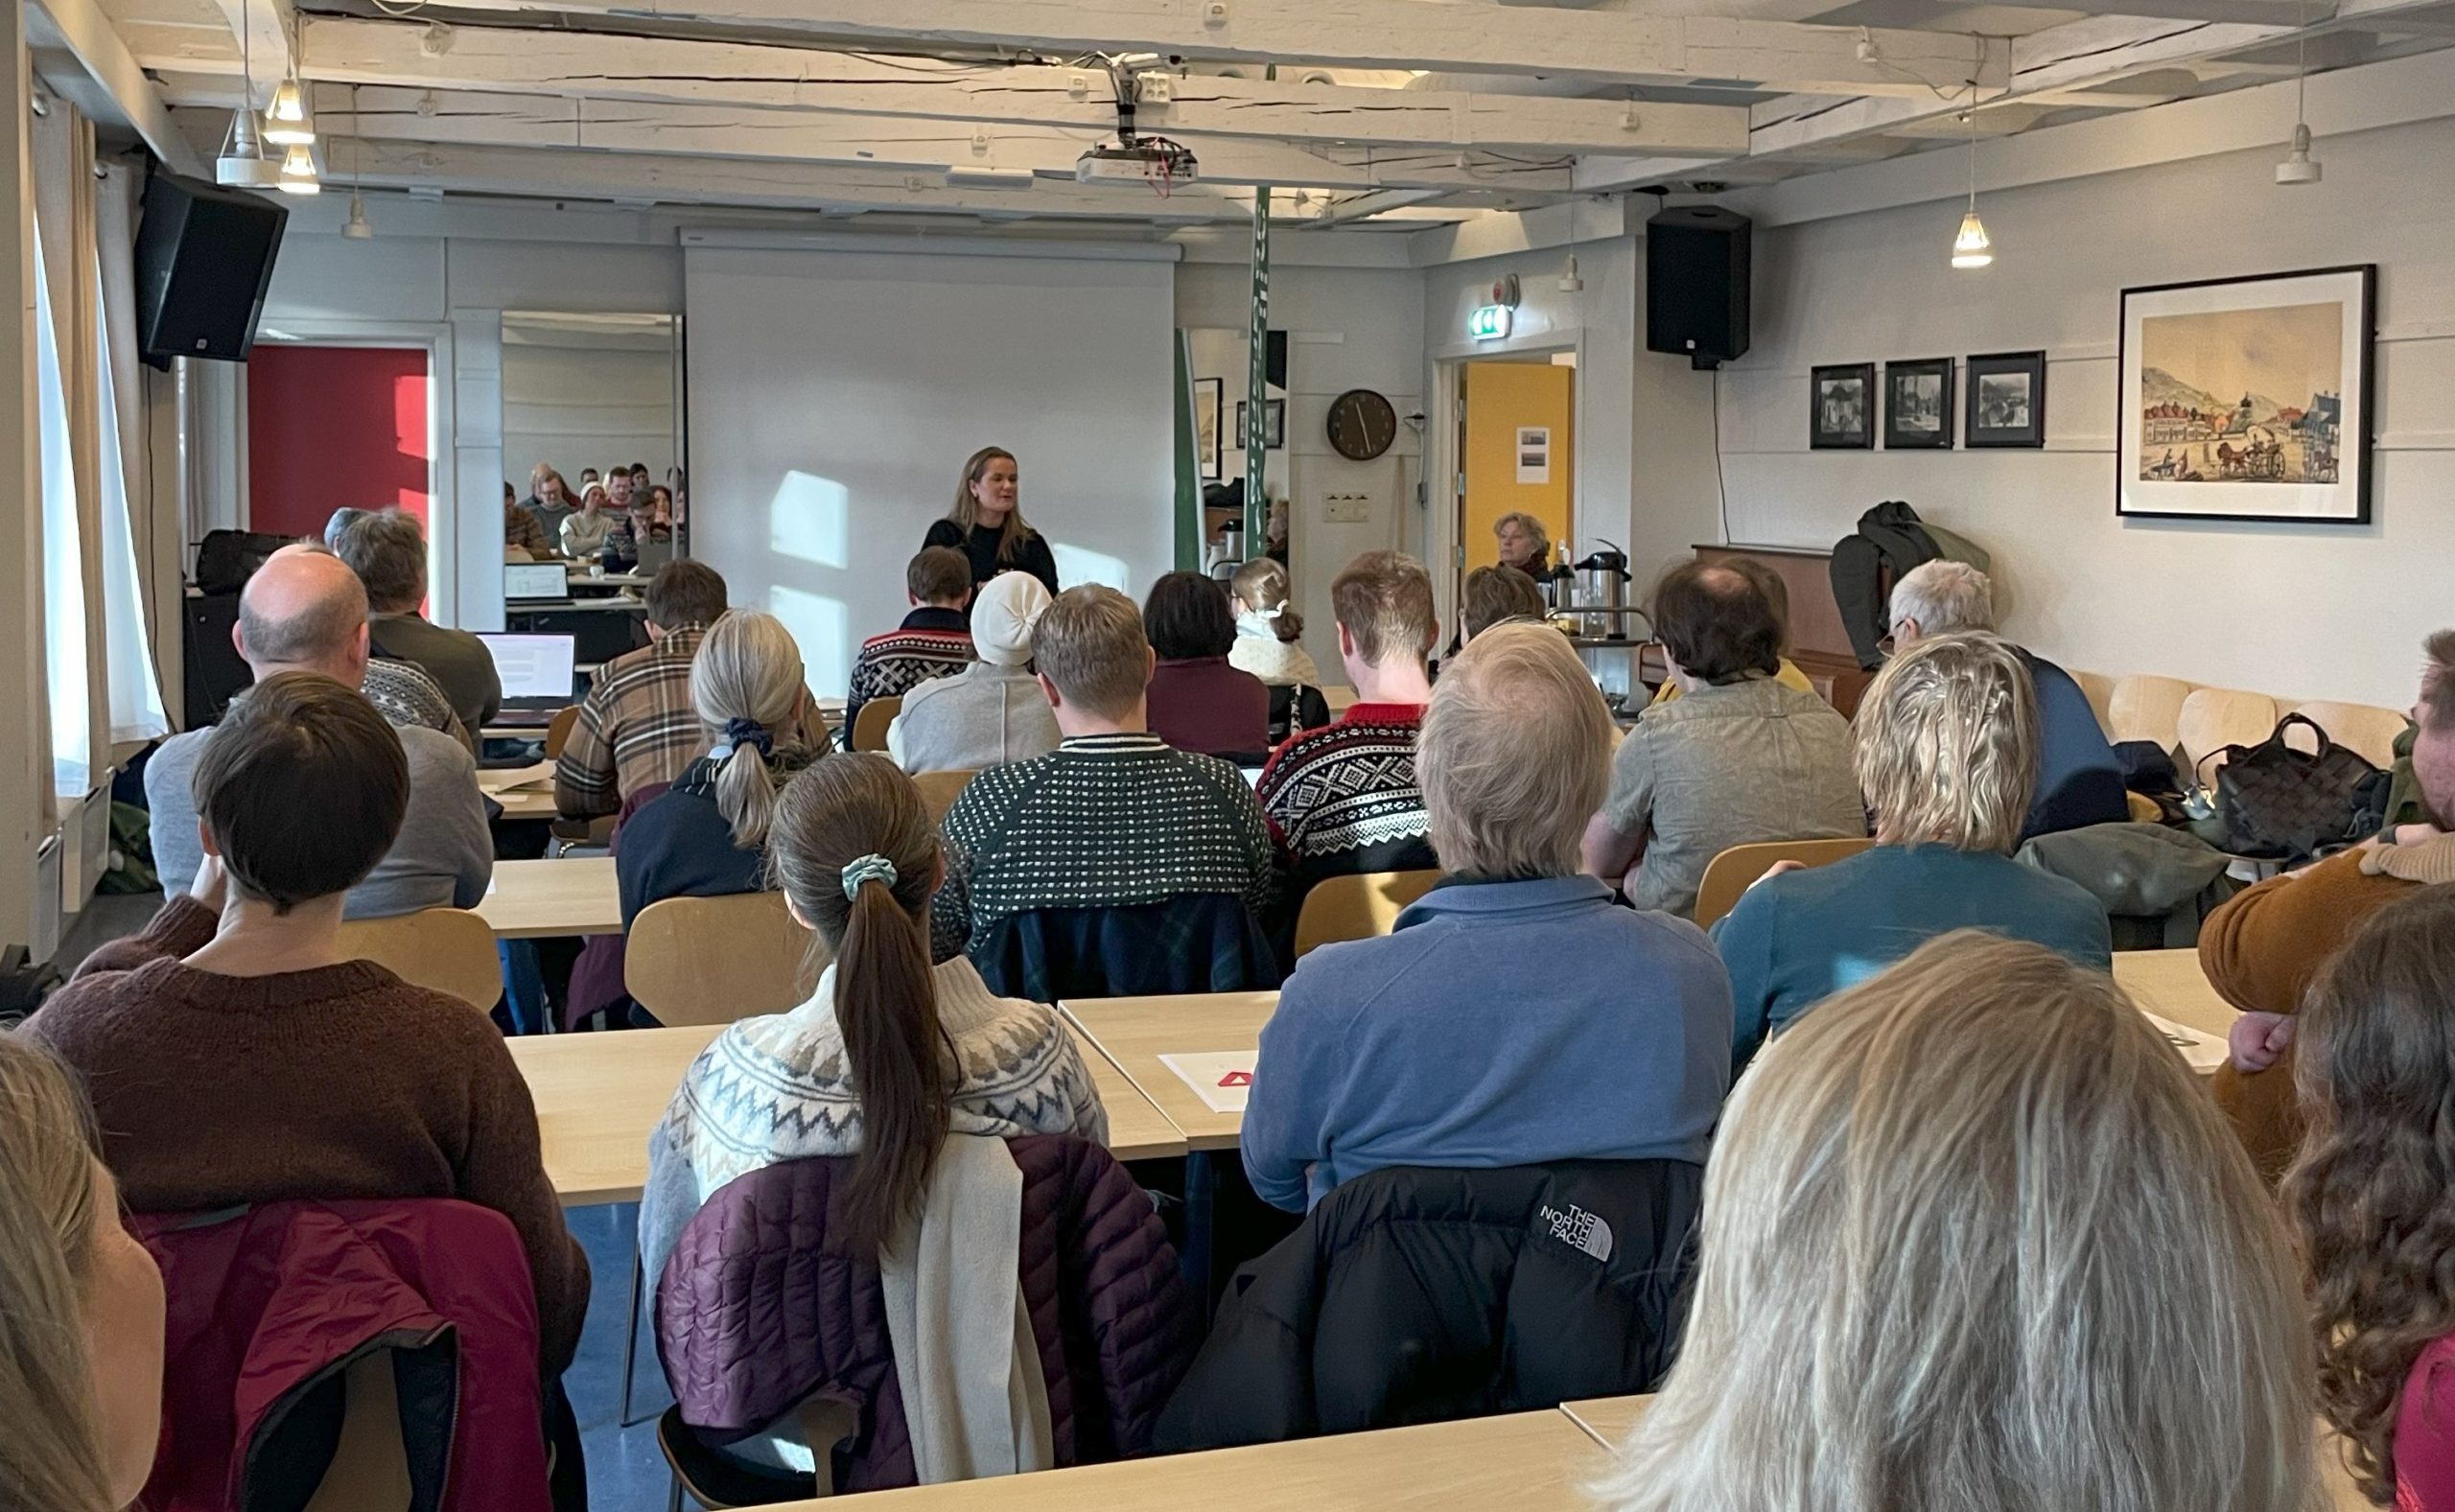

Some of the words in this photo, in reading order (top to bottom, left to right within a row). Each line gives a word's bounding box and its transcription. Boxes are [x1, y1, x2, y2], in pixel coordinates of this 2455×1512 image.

[1540, 1205, 1592, 1238] NORTH
[1569, 1204, 1596, 1226] THE
[1550, 1223, 1588, 1249] FACE
